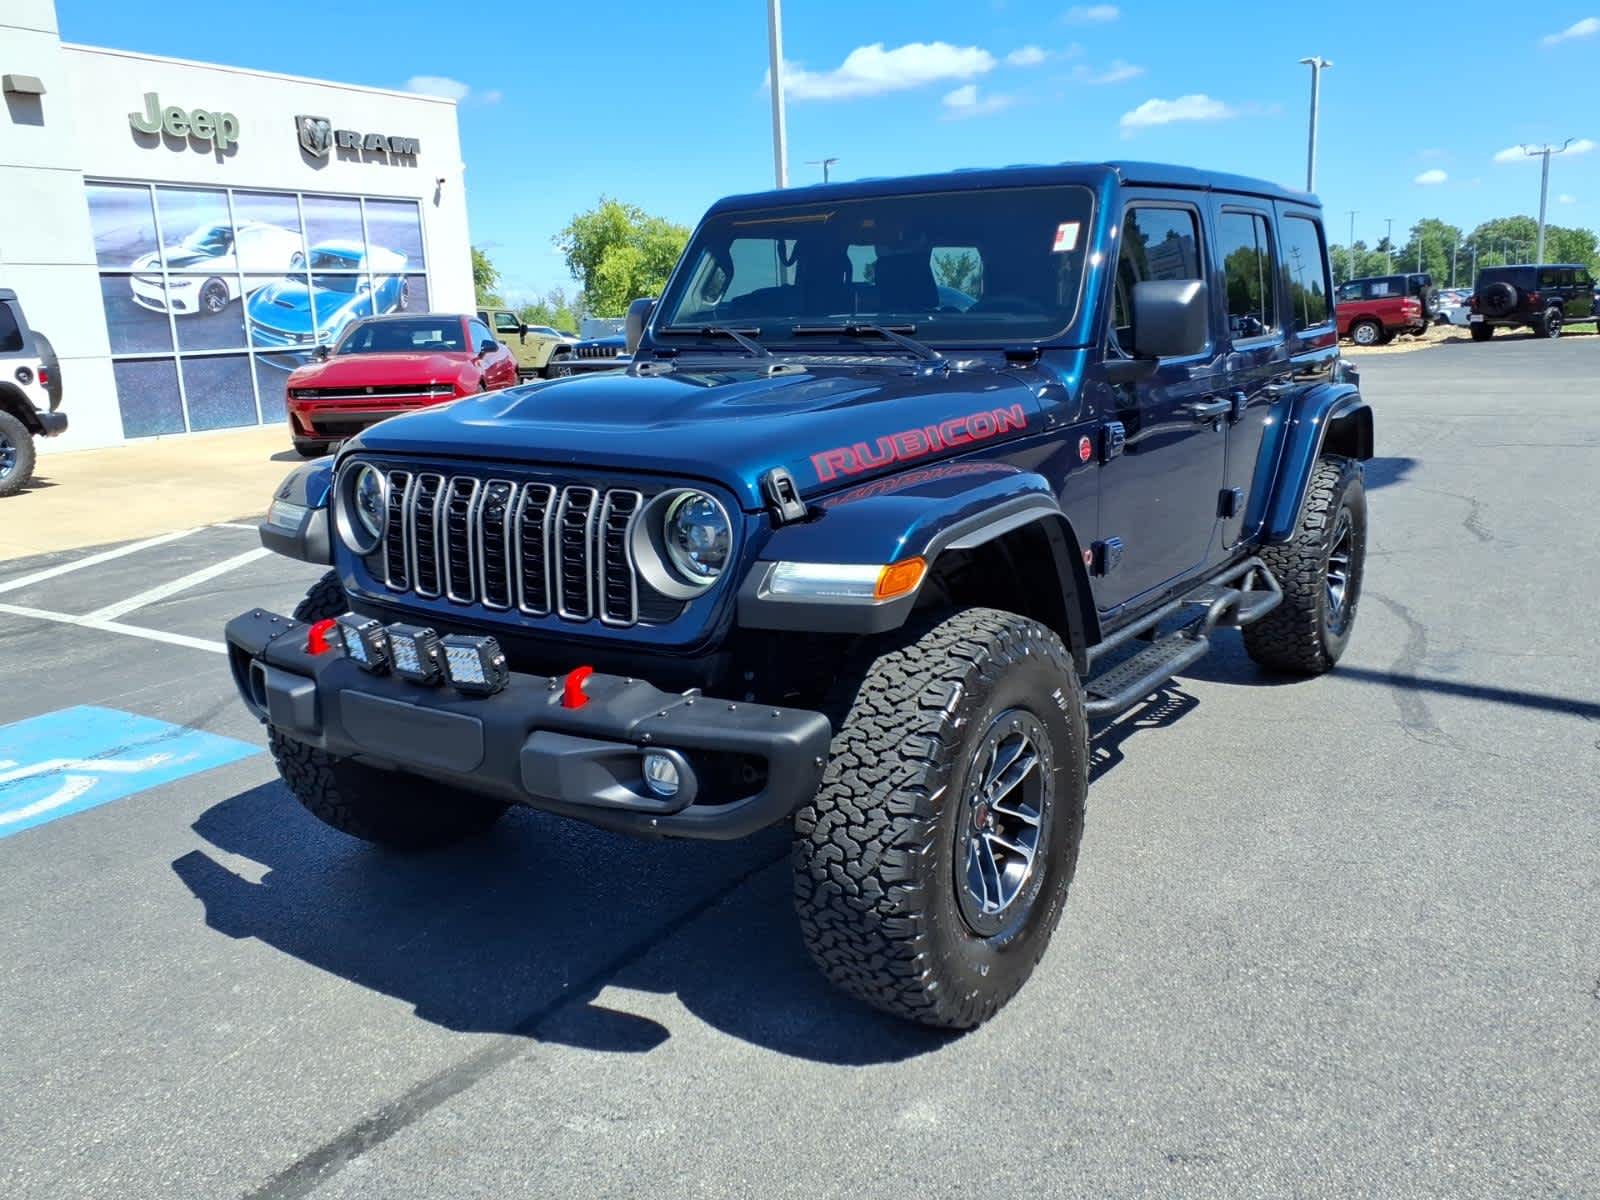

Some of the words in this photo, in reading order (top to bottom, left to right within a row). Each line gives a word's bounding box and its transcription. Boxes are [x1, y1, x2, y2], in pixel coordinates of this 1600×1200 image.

[128, 91, 240, 150] Jeep
[334, 129, 421, 155] RAM
[809, 403, 1028, 483] RUBICON
